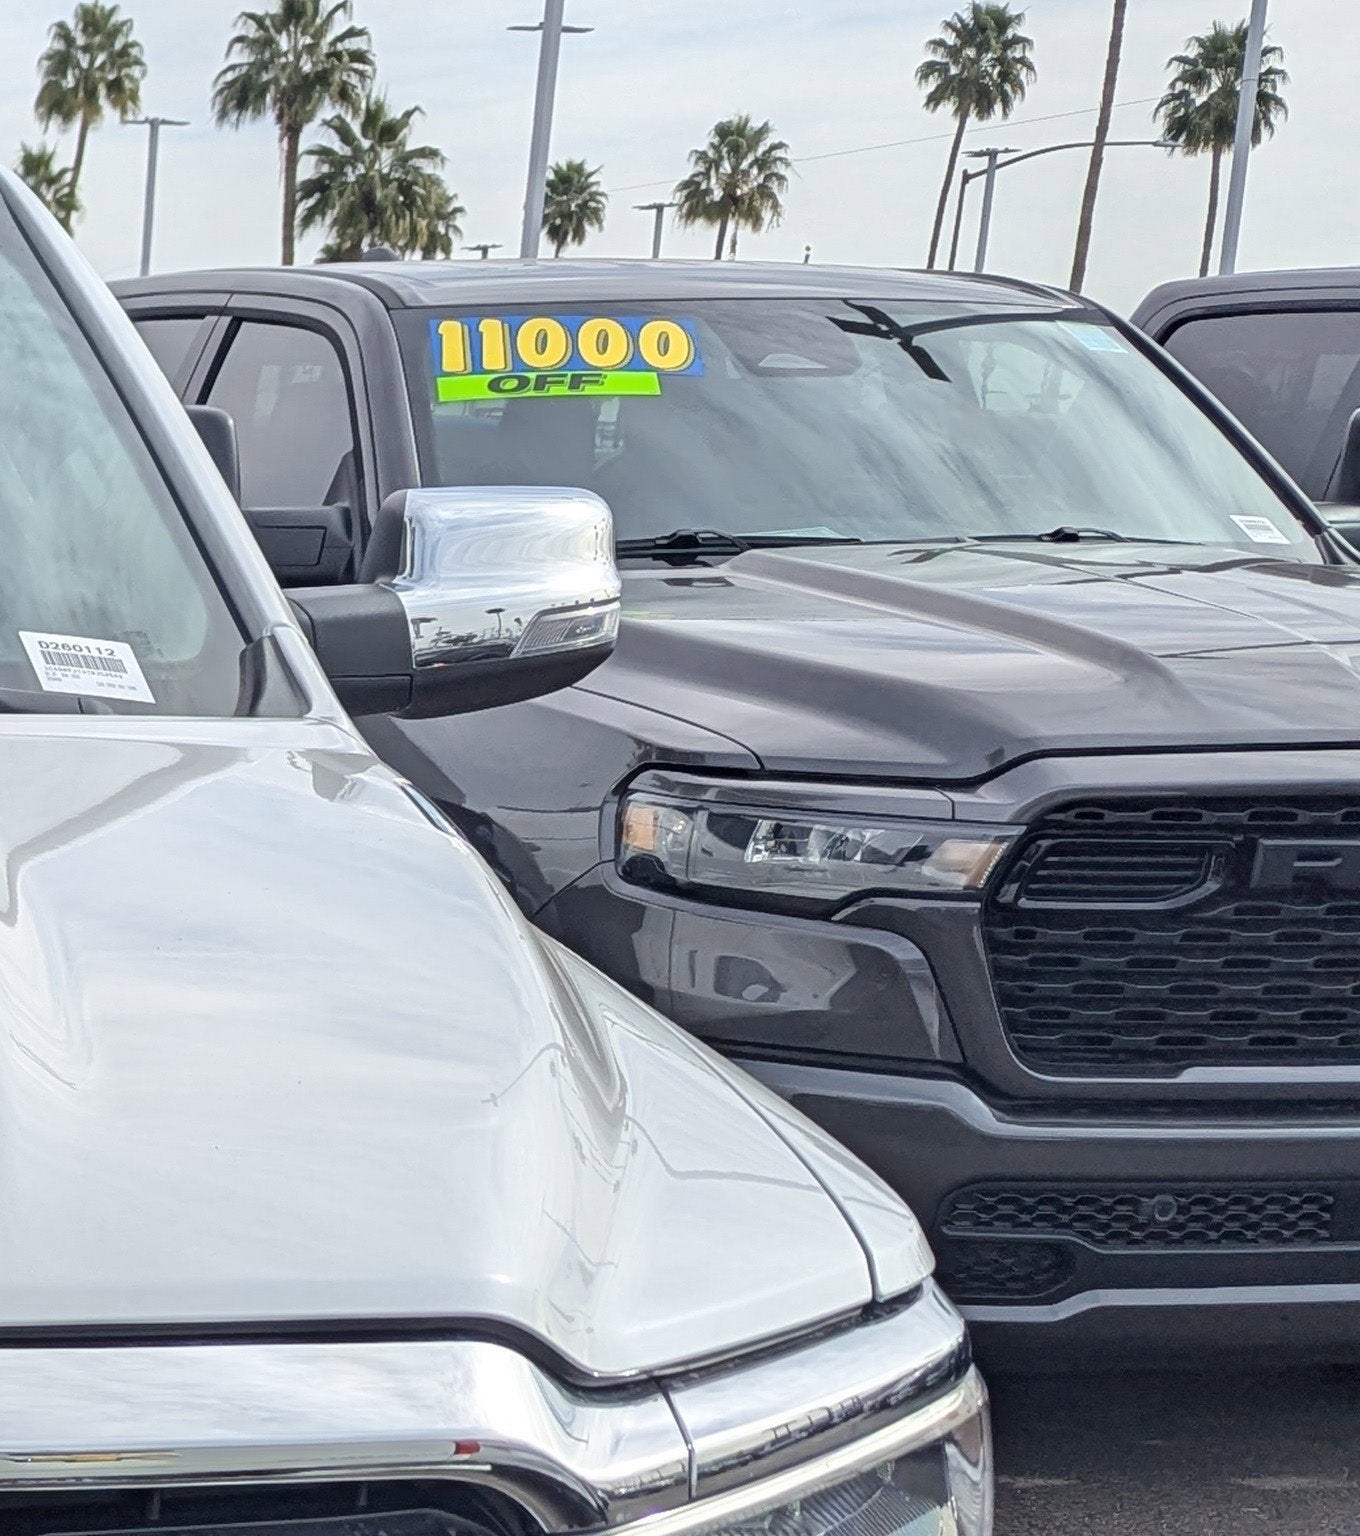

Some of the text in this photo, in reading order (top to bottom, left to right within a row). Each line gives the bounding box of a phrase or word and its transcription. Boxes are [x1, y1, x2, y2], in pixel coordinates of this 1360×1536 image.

[437, 317, 696, 374] 11000
[487, 373, 608, 394] OFF
[37, 640, 117, 658] D260112
